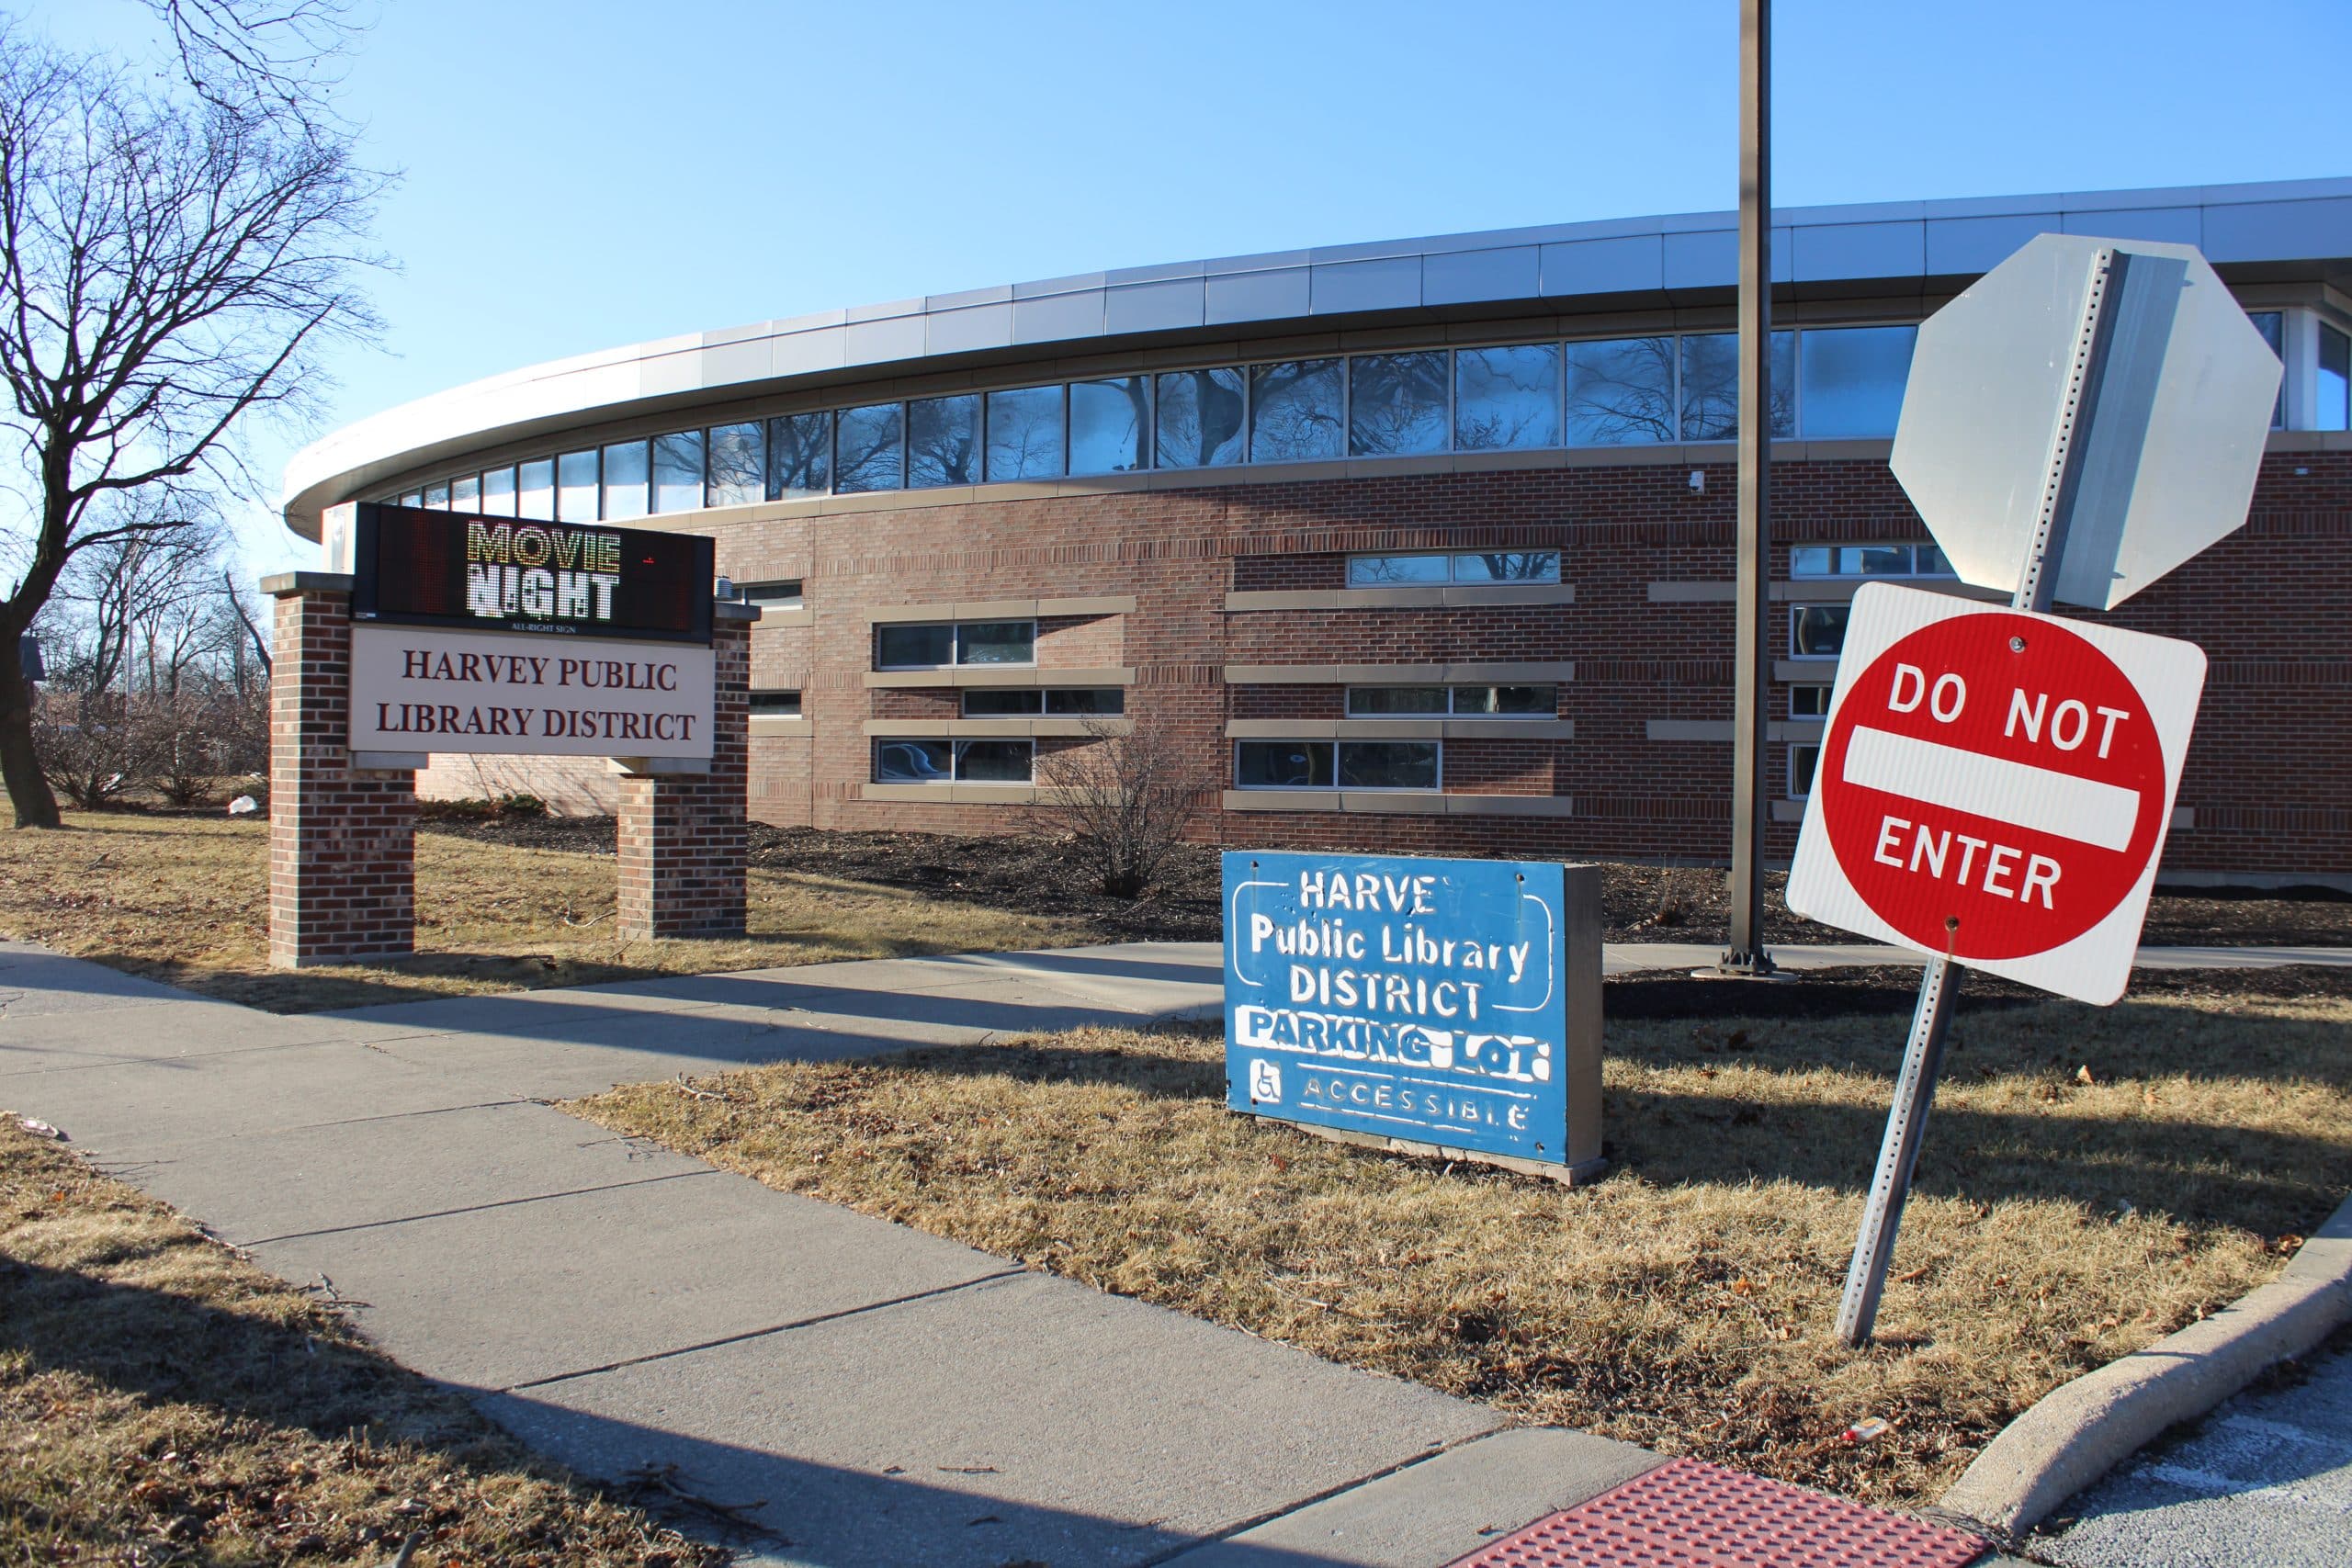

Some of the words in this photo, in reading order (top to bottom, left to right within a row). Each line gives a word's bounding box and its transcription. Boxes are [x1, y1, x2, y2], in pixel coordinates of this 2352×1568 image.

[467, 520, 621, 574] MOVIE
[466, 562, 620, 621] NIGHT
[512, 622, 554, 633] ALL-RIGHT
[555, 625, 577, 634] SIGN
[401, 649, 549, 686] HARVEY
[558, 658, 678, 692] PUBLIC
[375, 703, 534, 737] LIBRARY
[541, 708, 696, 741] DISTRICT
[1888, 662, 1967, 724] DO
[2004, 687, 2131, 760] NOT
[1873, 815, 2063, 910] ENTER
[1300, 870, 1452, 913] HARVE
[1250, 912, 1365, 959] Public
[1382, 922, 1529, 983] Library
[1290, 964, 1483, 1020] DISTRICT
[1248, 1010, 1430, 1067] PARKING
[1453, 1033, 1534, 1078] LOT
